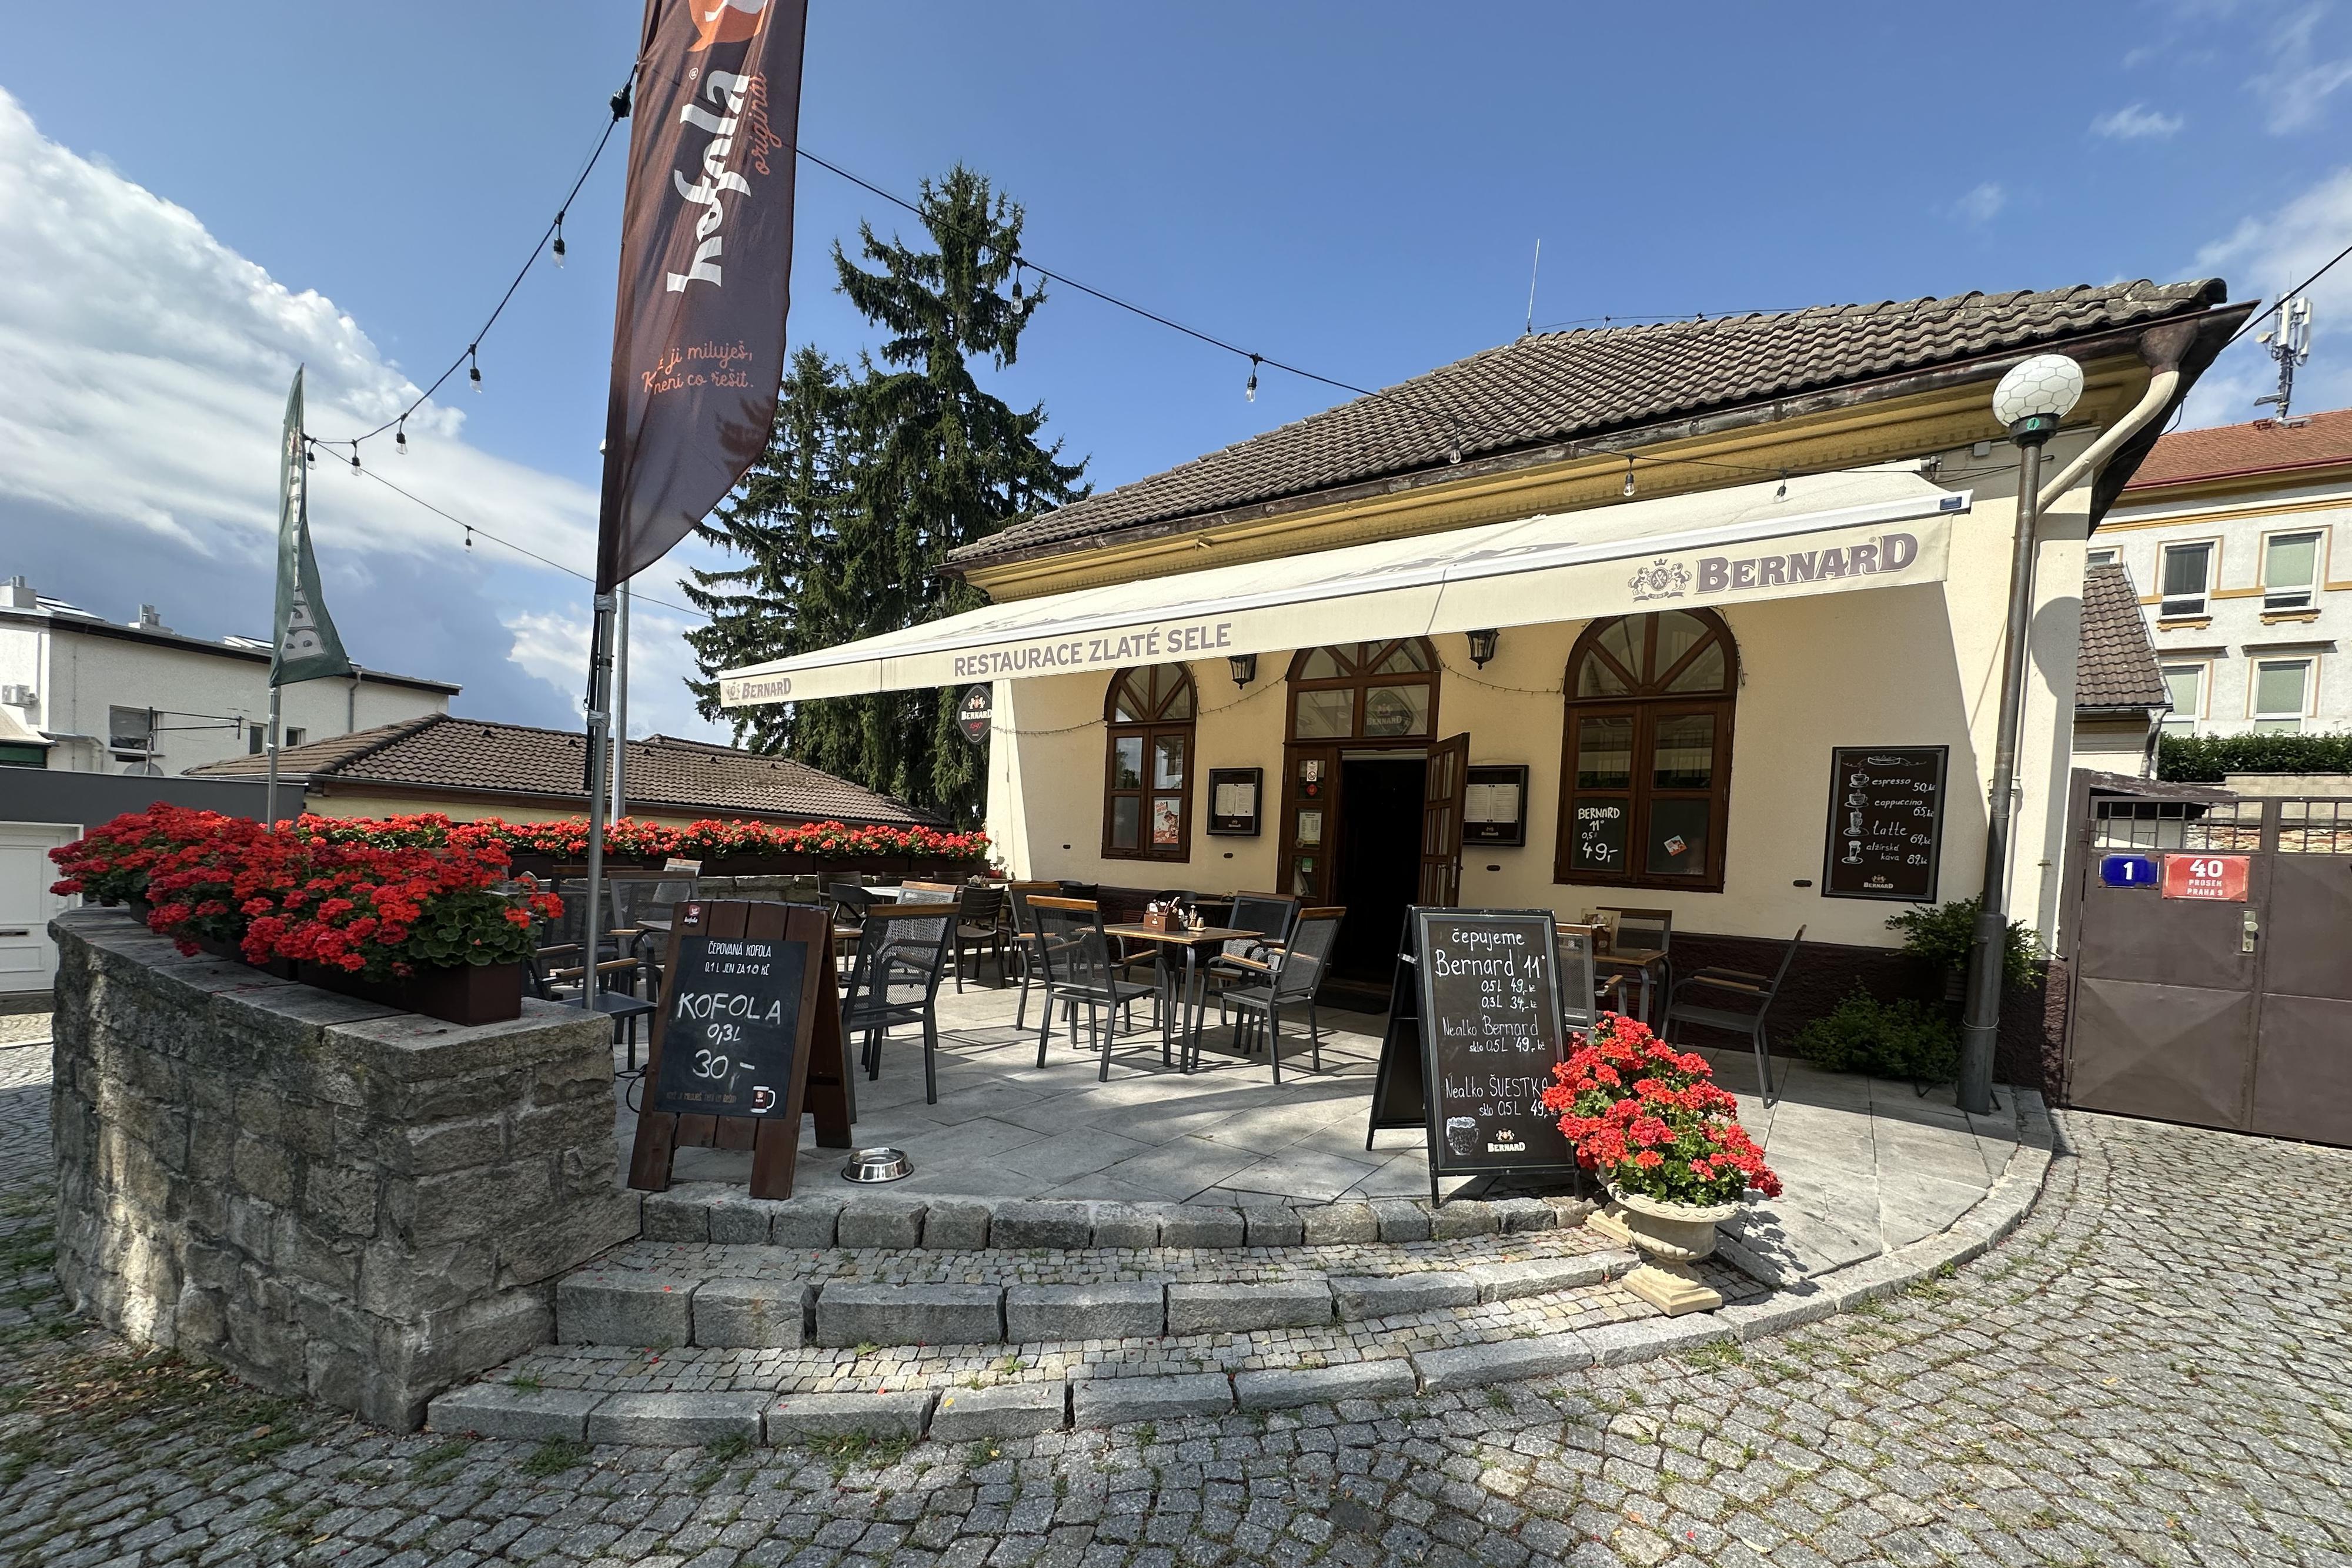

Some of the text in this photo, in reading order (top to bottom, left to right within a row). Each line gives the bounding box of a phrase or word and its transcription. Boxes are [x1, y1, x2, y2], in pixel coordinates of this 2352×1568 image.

[667, 69, 751, 293] kofola
[687, 374, 707, 386] co
[711, 368, 754, 388] řešit.
[1694, 532, 1919, 595] BERNARD
[954, 623, 1231, 677] RESTAURACE ZLATÉ SELE
[741, 677, 791, 700] BERNARD
[961, 709, 992, 720] BERNARD
[1367, 716, 1402, 726] BERNARD
[1872, 778, 1911, 787] espresso
[1875, 798, 1923, 808] cappuccino
[1578, 807, 1620, 820] BERNARD
[1880, 852, 1900, 861] káva
[2123, 861, 2133, 880] 1
[2189, 859, 2223, 878] 40
[1452, 928, 1525, 951] čepujeme
[707, 941, 771, 958] ČEPOVANÁ KOFOLA
[722, 963, 735, 973] JEN
[736, 964, 746, 974] ZA
[761, 964, 770, 975] KČ
[1435, 948, 1515, 978] Bernard
[677, 992, 781, 1025] KOFOLA
[1482, 1014, 1539, 1036] Bernard
[1469, 1041, 1484, 1053] sklo
[1487, 1142, 1526, 1153] BERNARD
